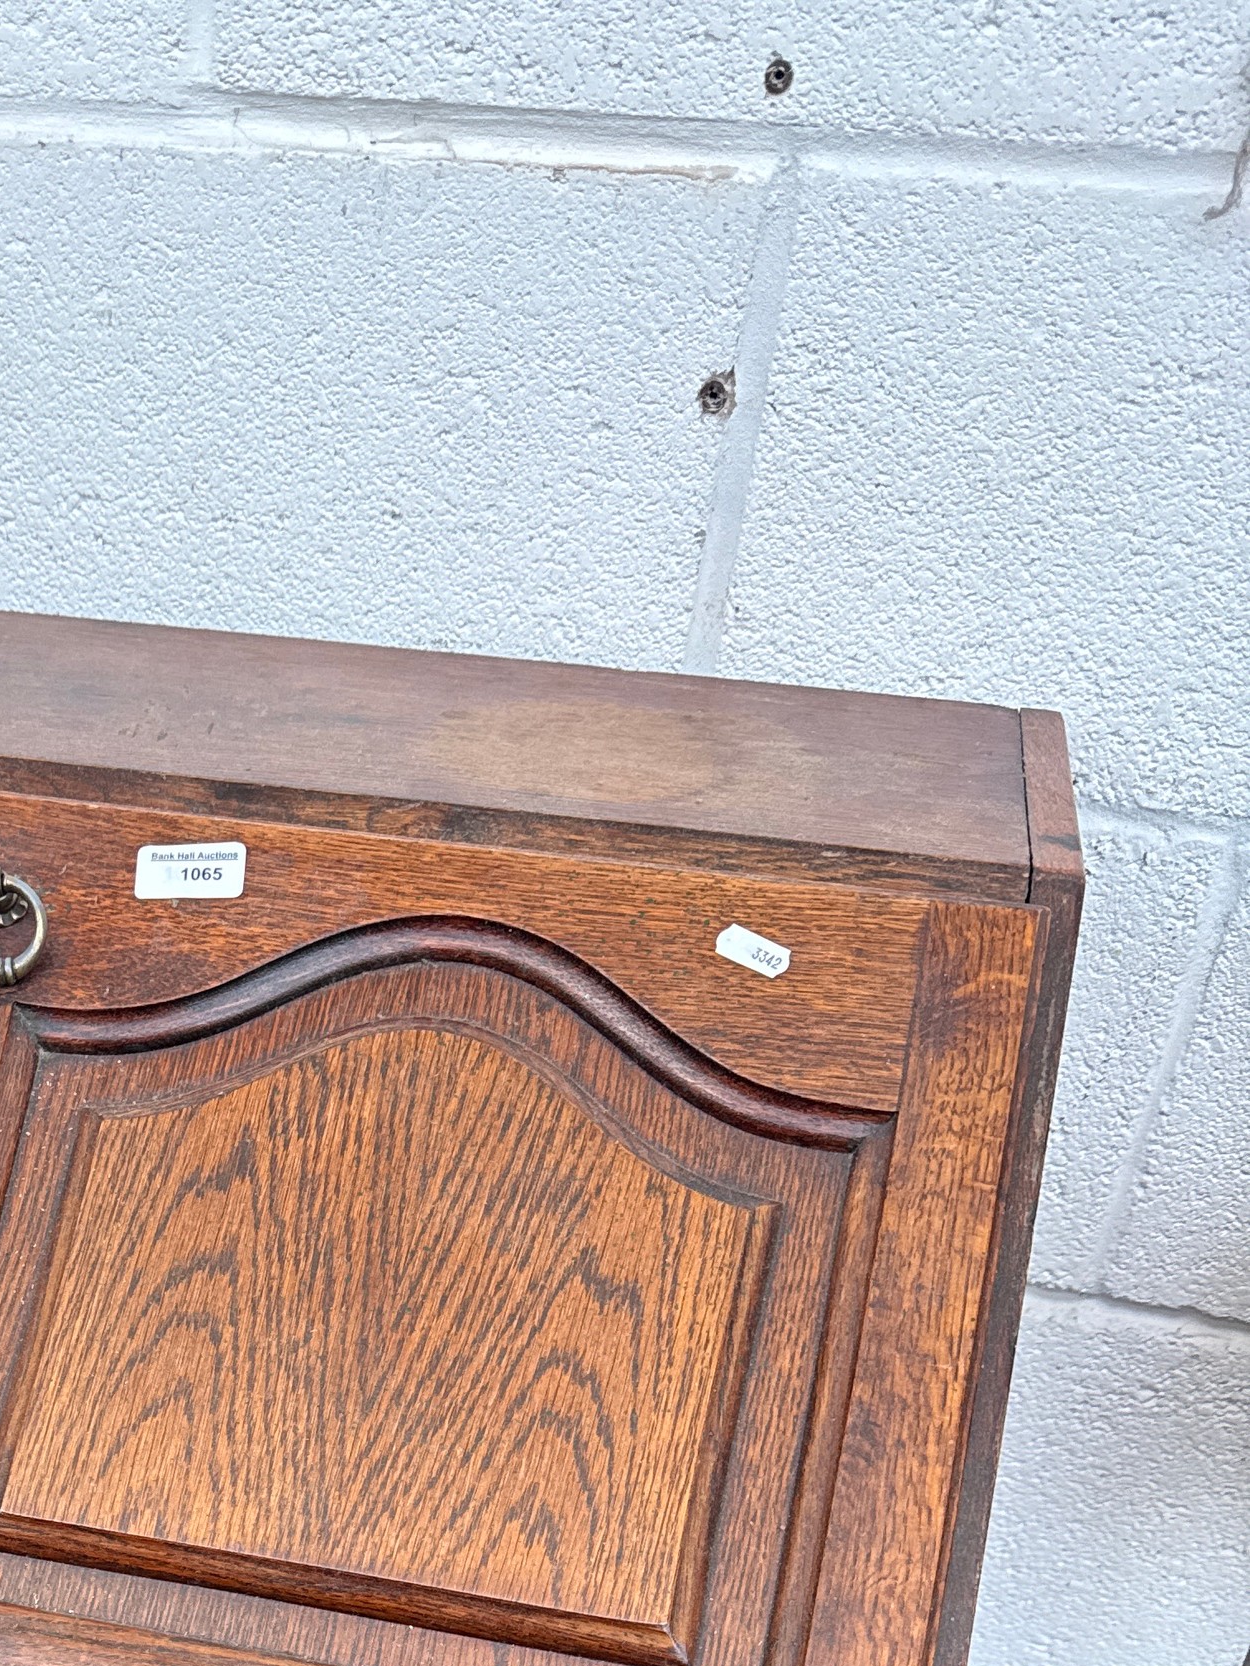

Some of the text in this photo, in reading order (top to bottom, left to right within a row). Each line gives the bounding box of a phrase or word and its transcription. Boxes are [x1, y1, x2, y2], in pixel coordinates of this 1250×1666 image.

[151, 851, 239, 861] Bank Hall Auctions
[180, 867, 223, 881] 1065
[751, 947, 783, 970] 3342
